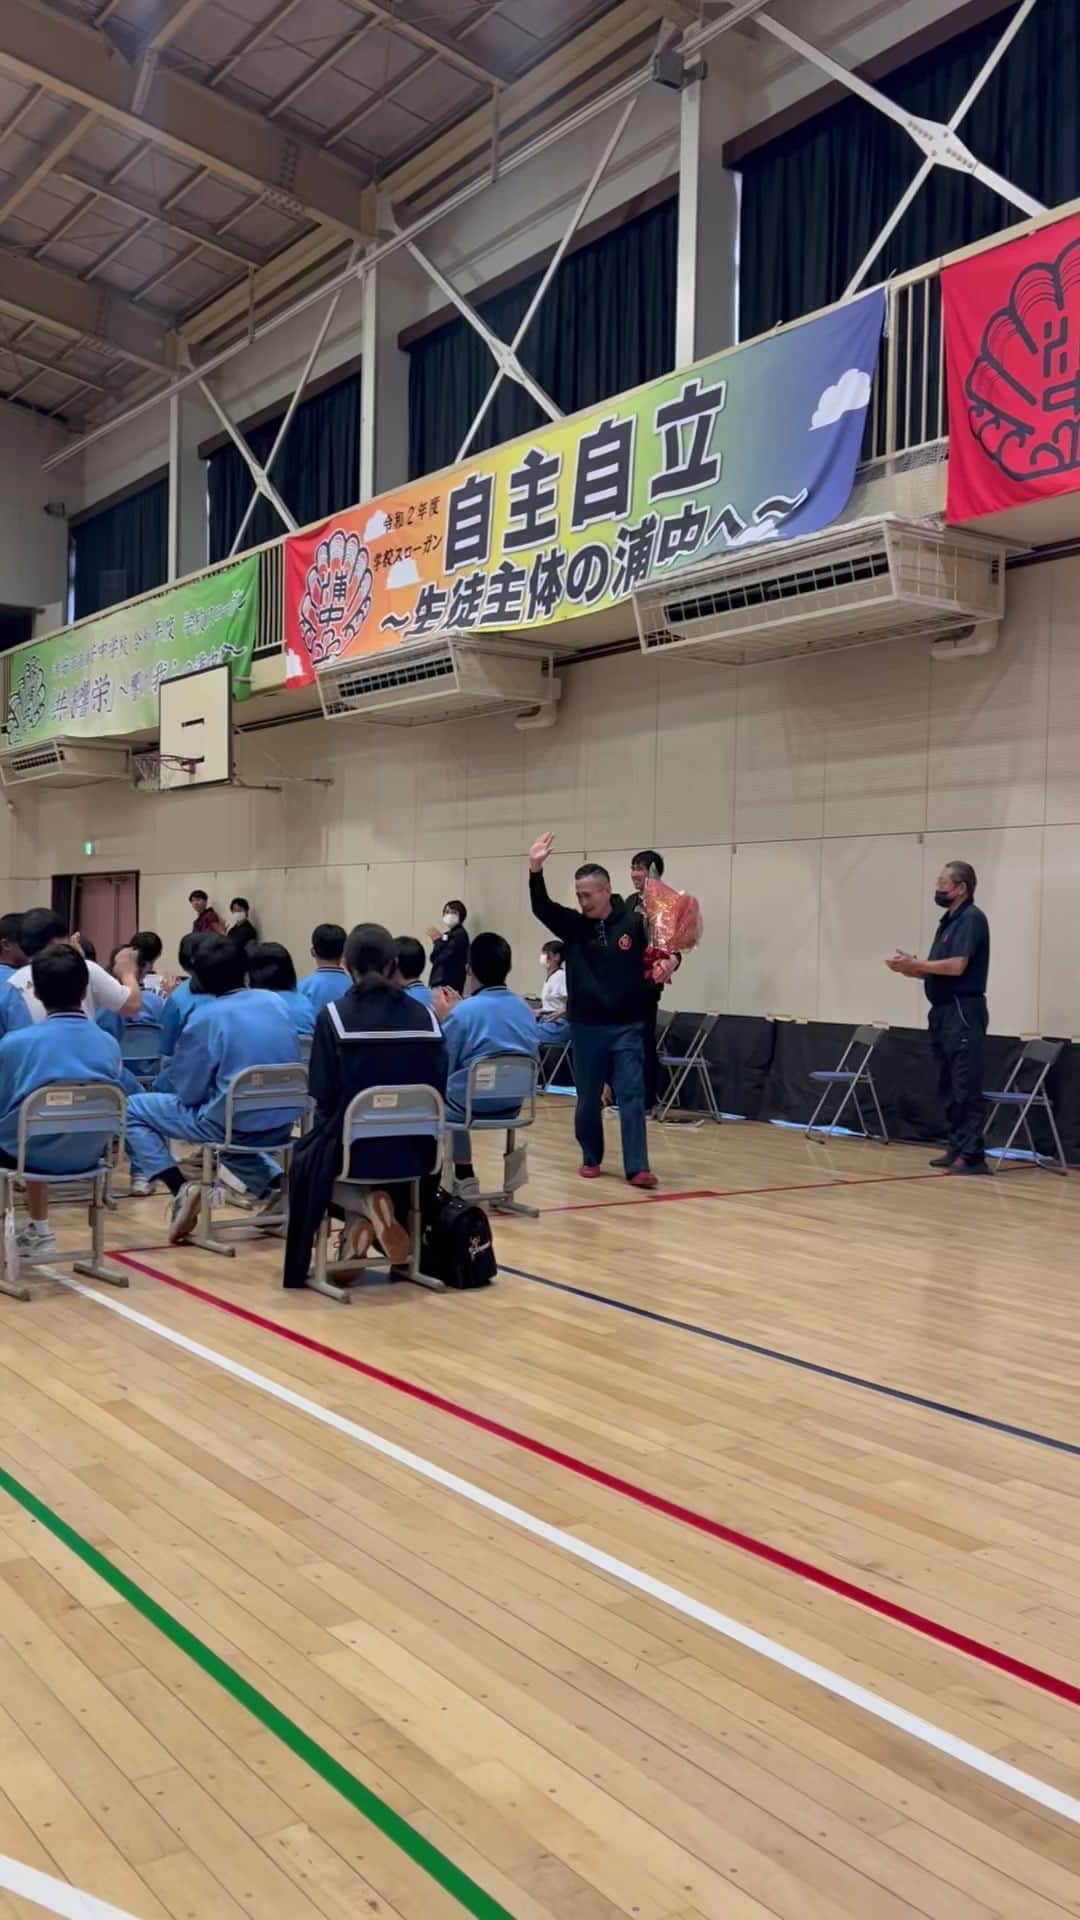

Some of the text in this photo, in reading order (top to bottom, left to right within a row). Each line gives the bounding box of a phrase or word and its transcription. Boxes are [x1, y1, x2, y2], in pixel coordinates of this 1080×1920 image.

[444, 378, 727, 576] 自主自立
[373, 533, 443, 572] 学校スローガン
